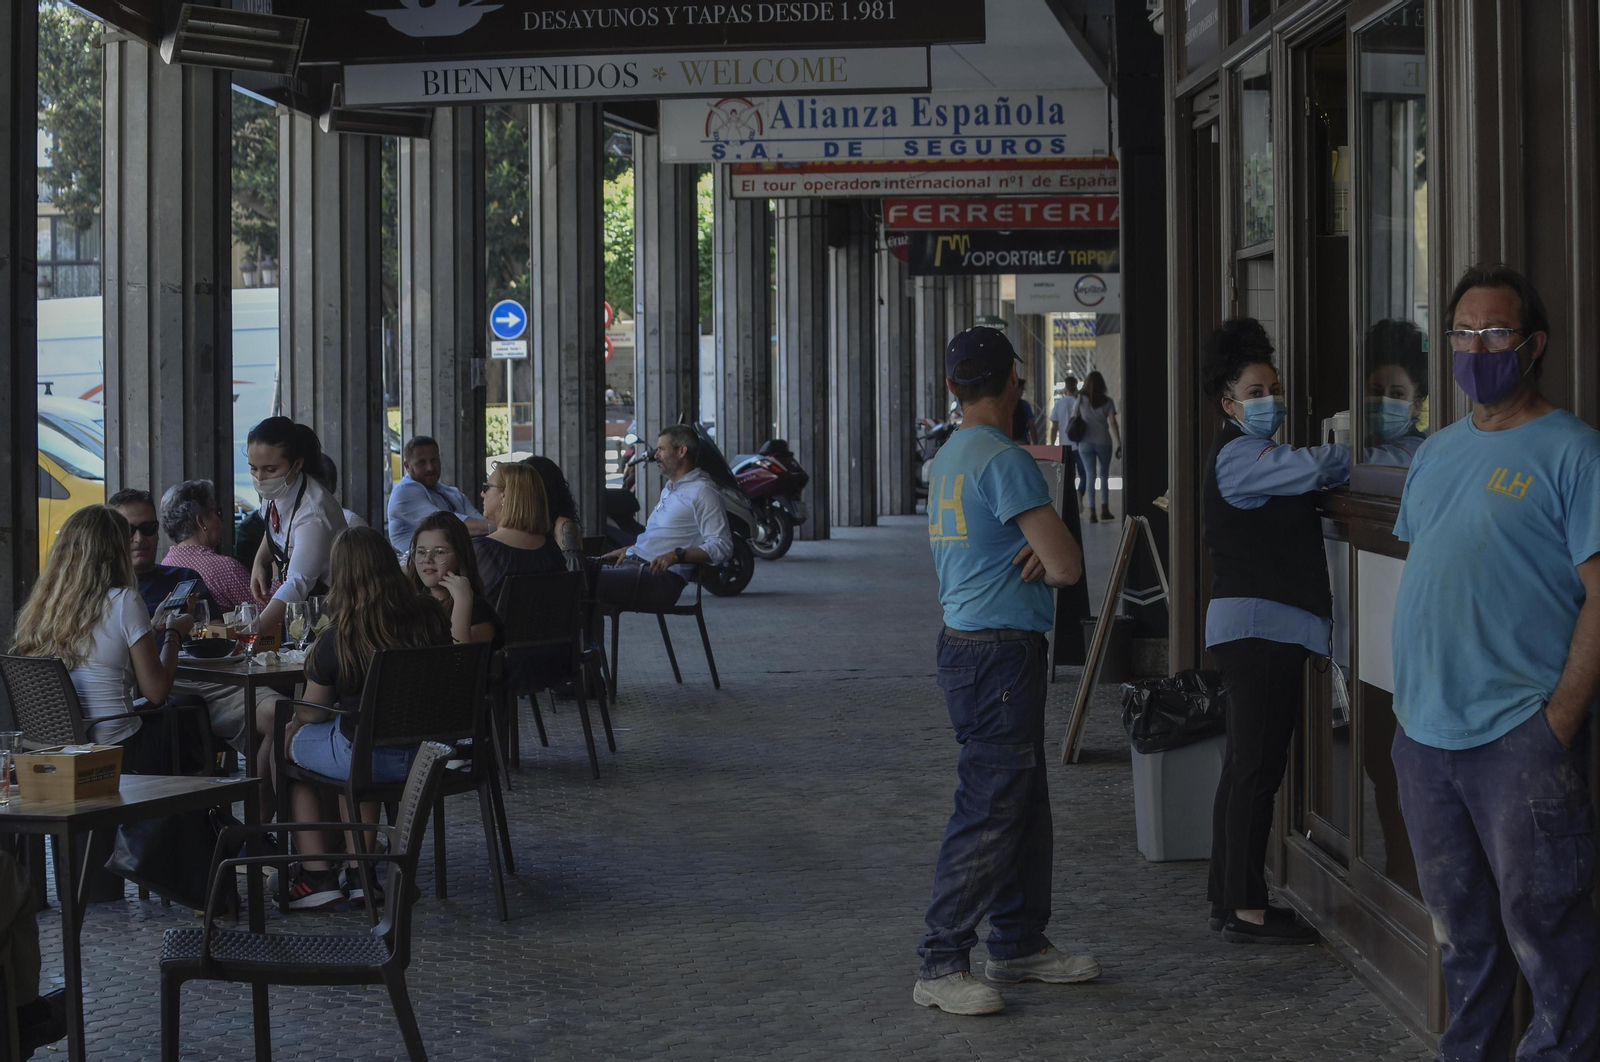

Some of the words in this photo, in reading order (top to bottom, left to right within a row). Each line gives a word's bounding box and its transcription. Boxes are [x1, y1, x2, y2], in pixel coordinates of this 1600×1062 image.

[523, 7, 659, 31] DESAYUNOS
[664, 6, 679, 26] Y
[682, 3, 752, 25] TAPAS
[757, 1, 834, 23] DESDE
[842, 0, 896, 21] 1.981
[422, 62, 639, 97] BIENVENIDOS
[678, 56, 848, 86] WELCOME
[770, 98, 898, 130] Alianza
[911, 95, 1066, 134] Española
[824, 140, 863, 158] DE
[904, 137, 1066, 156] SEGUROS
[741, 178, 758, 193] El
[763, 179, 797, 193] tour
[804, 176, 878, 197] operador
[884, 174, 990, 191] internacional
[1032, 173, 1051, 188] de
[1060, 172, 1118, 192] España
[963, 249, 1066, 267] SOPORTALES
[1069, 249, 1117, 266] TAPAS
